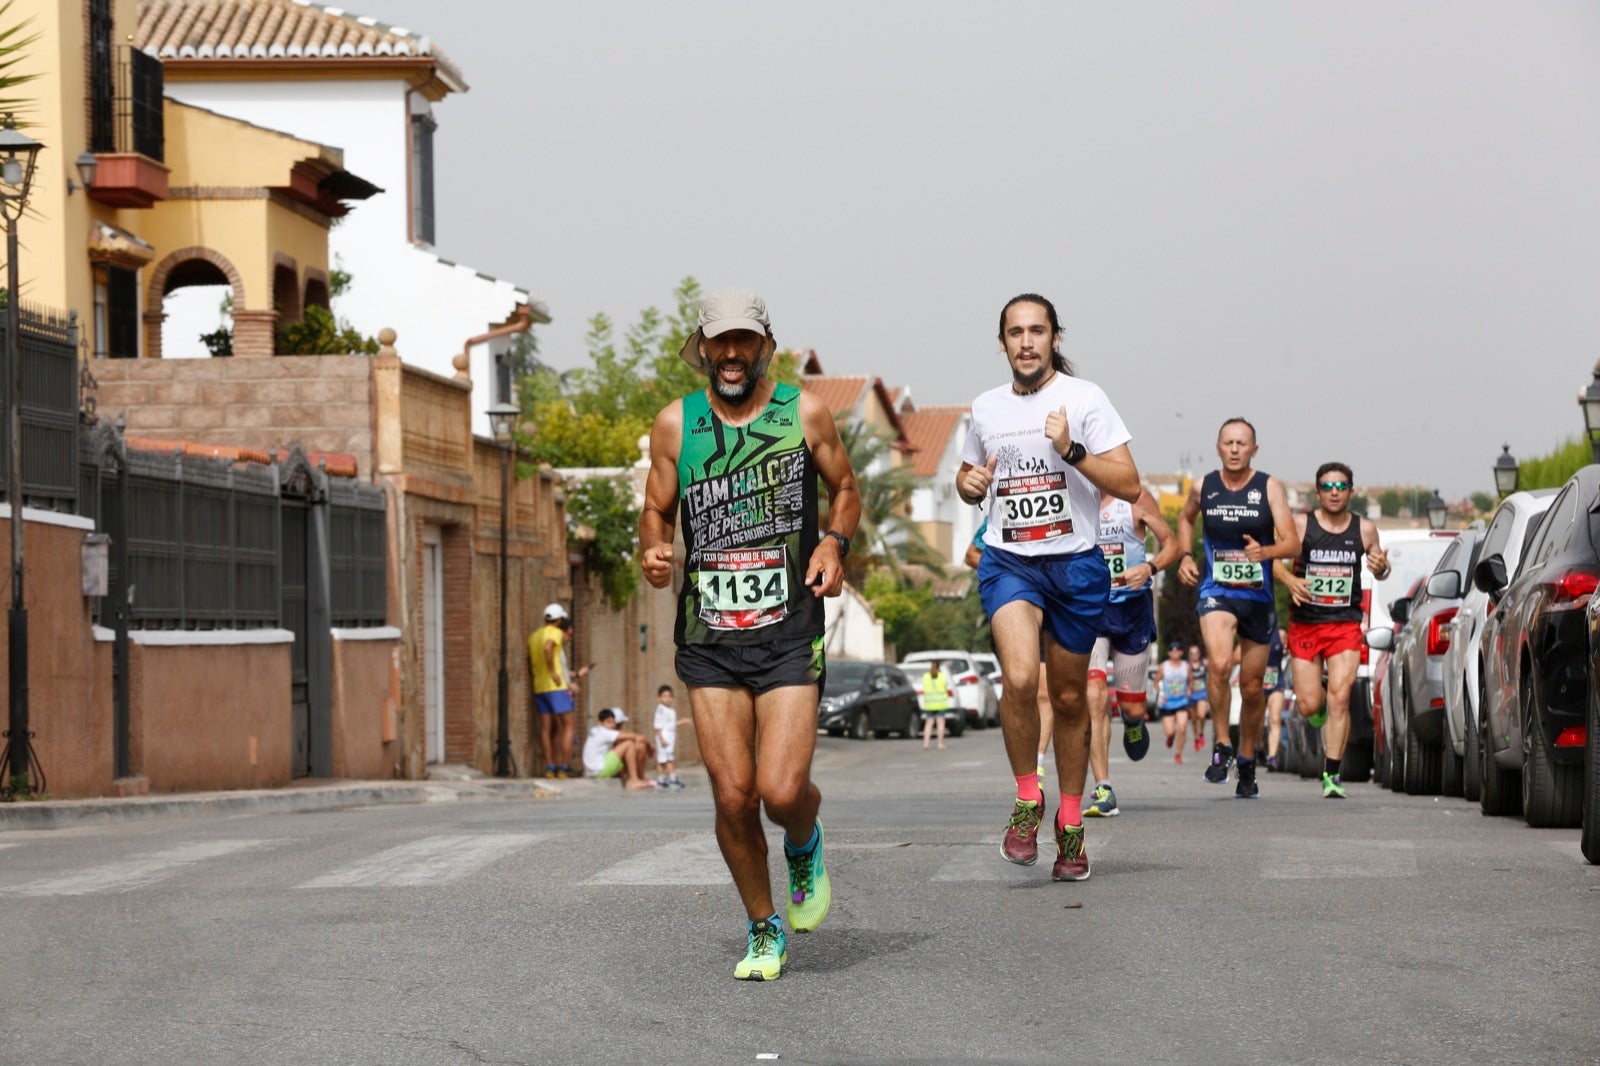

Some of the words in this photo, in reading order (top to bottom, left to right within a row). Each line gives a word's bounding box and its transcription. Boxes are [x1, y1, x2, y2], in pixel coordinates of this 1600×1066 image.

[685, 477, 729, 518] TEAM
[732, 451, 805, 498] HALCON
[1022, 476, 1038, 487] PREMIO
[1039, 475, 1045, 485] DE
[711, 505, 726, 521] DE
[728, 491, 773, 516] MENTE
[1005, 494, 1064, 520] 3029
[709, 520, 721, 541] DE
[723, 506, 773, 535] PIERNAS
[732, 523, 775, 544] RENDIRSE
[717, 552, 729, 562] GRAN
[730, 551, 752, 561] PREMIO
[753, 550, 760, 560] DE
[761, 549, 780, 560] FONDO
[1310, 549, 1356, 563] GRANADA
[1222, 564, 1255, 580] 953
[707, 572, 784, 604] 1134
[1314, 579, 1346, 593] 212
